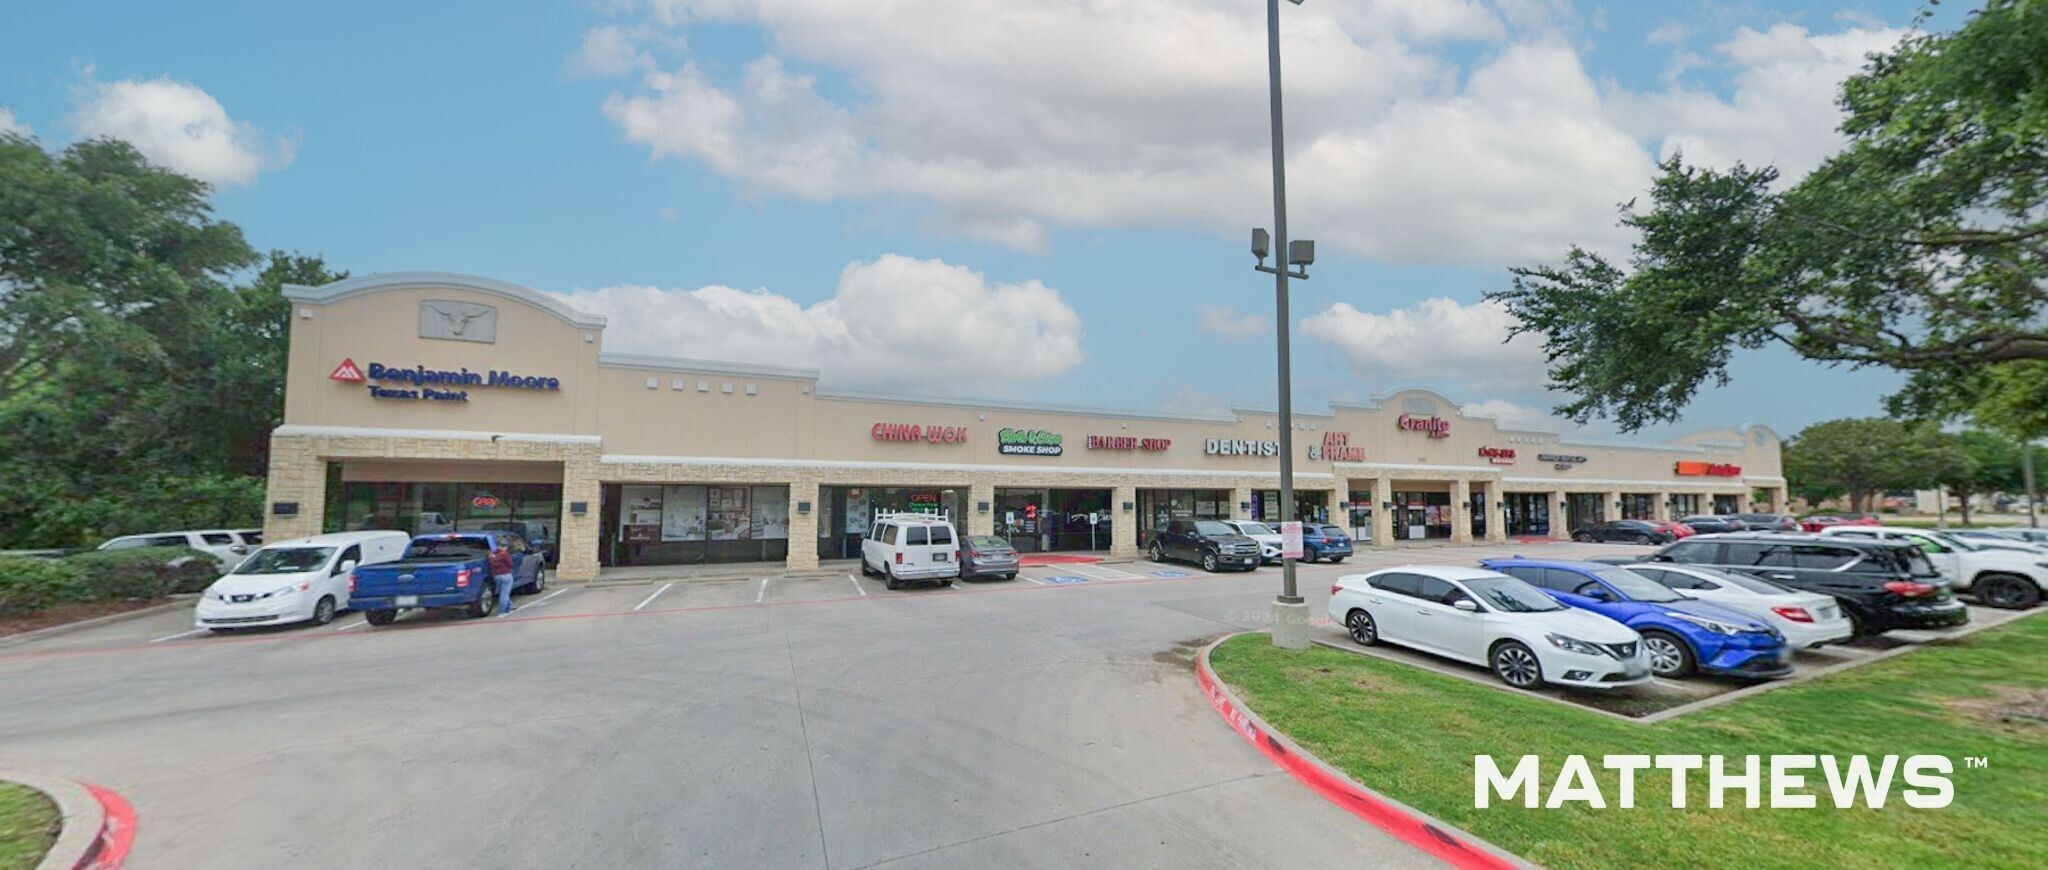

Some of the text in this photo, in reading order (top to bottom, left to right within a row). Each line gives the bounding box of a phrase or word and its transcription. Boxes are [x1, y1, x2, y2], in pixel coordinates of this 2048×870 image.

[368, 362, 560, 390] Benjamin Moore
[368, 386, 468, 401] Texas Paint
[1398, 413, 1450, 431] Granite
[871, 422, 967, 443] CHINA WOK
[1323, 431, 1350, 446] ART
[1003, 445, 1061, 454] SMOKE SHOP
[1090, 435, 1137, 449] BARBER
[1141, 438, 1172, 451] SHOP
[1205, 437, 1280, 457] DENTIST
[1308, 444, 1366, 462] & FRAME
[911, 494, 936, 502] OPEN
